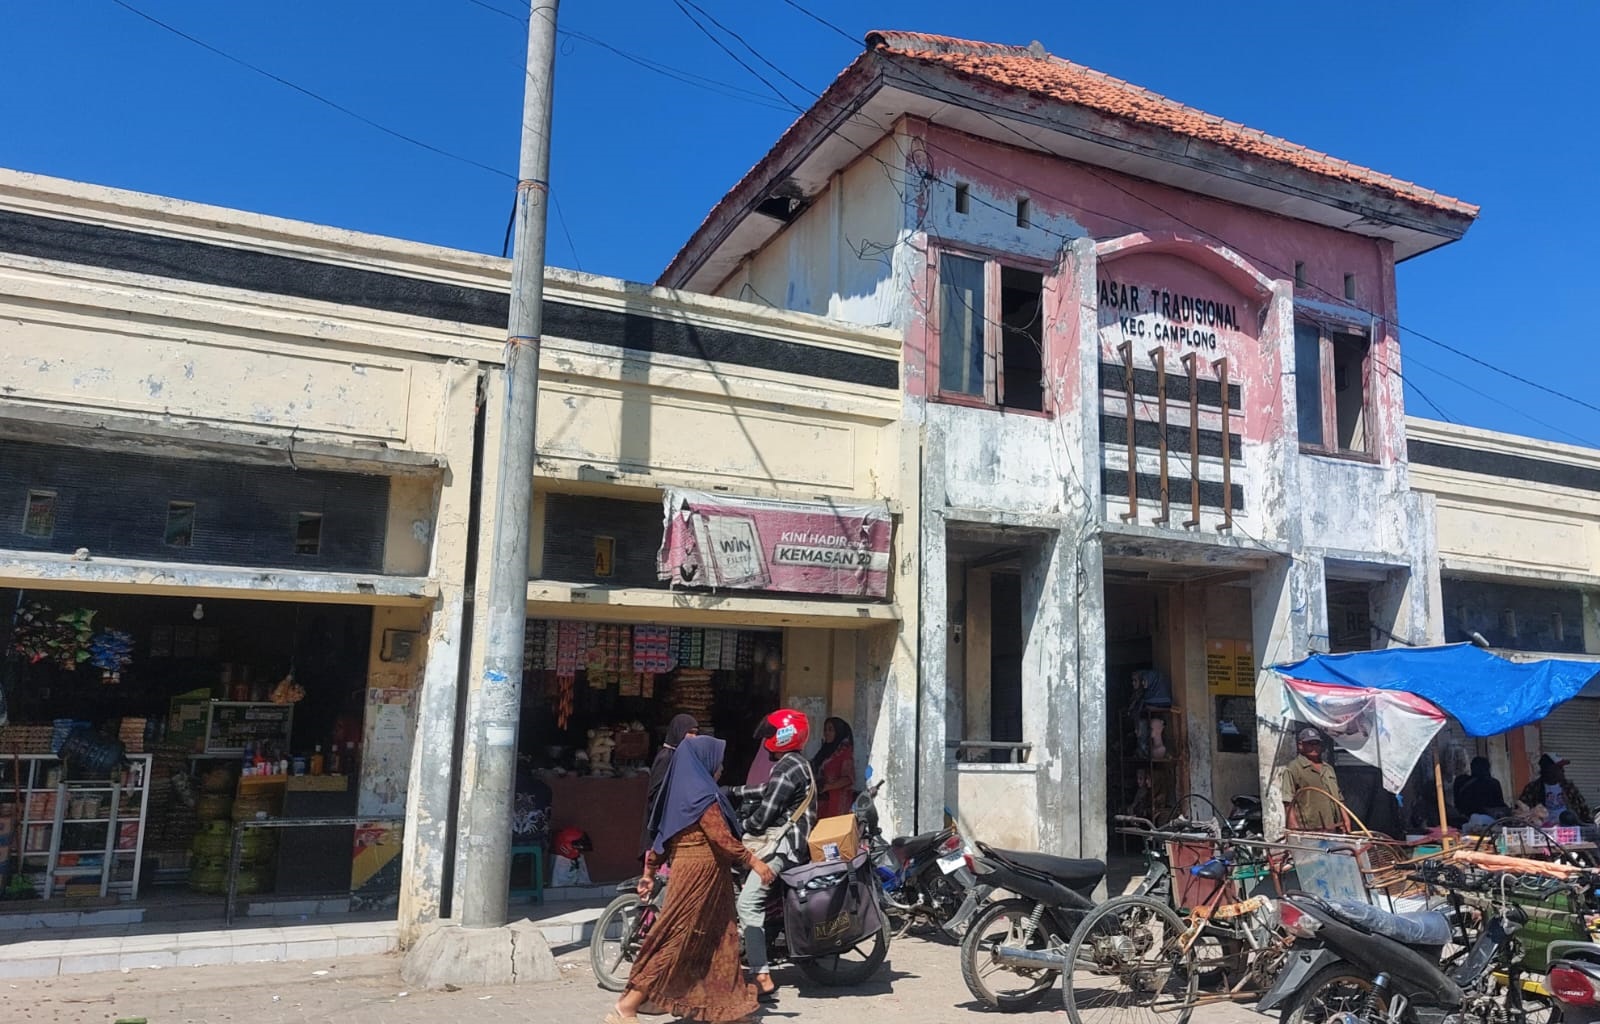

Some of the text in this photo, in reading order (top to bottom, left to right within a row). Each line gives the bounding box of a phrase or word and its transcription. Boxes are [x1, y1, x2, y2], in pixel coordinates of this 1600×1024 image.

[1151, 289, 1240, 332] TRADISIONAL
[1154, 322, 1216, 350] CAMPLONG
[781, 531, 807, 543] KINI
[809, 533, 848, 547] HADIR
[779, 547, 854, 565] KEMASAN
